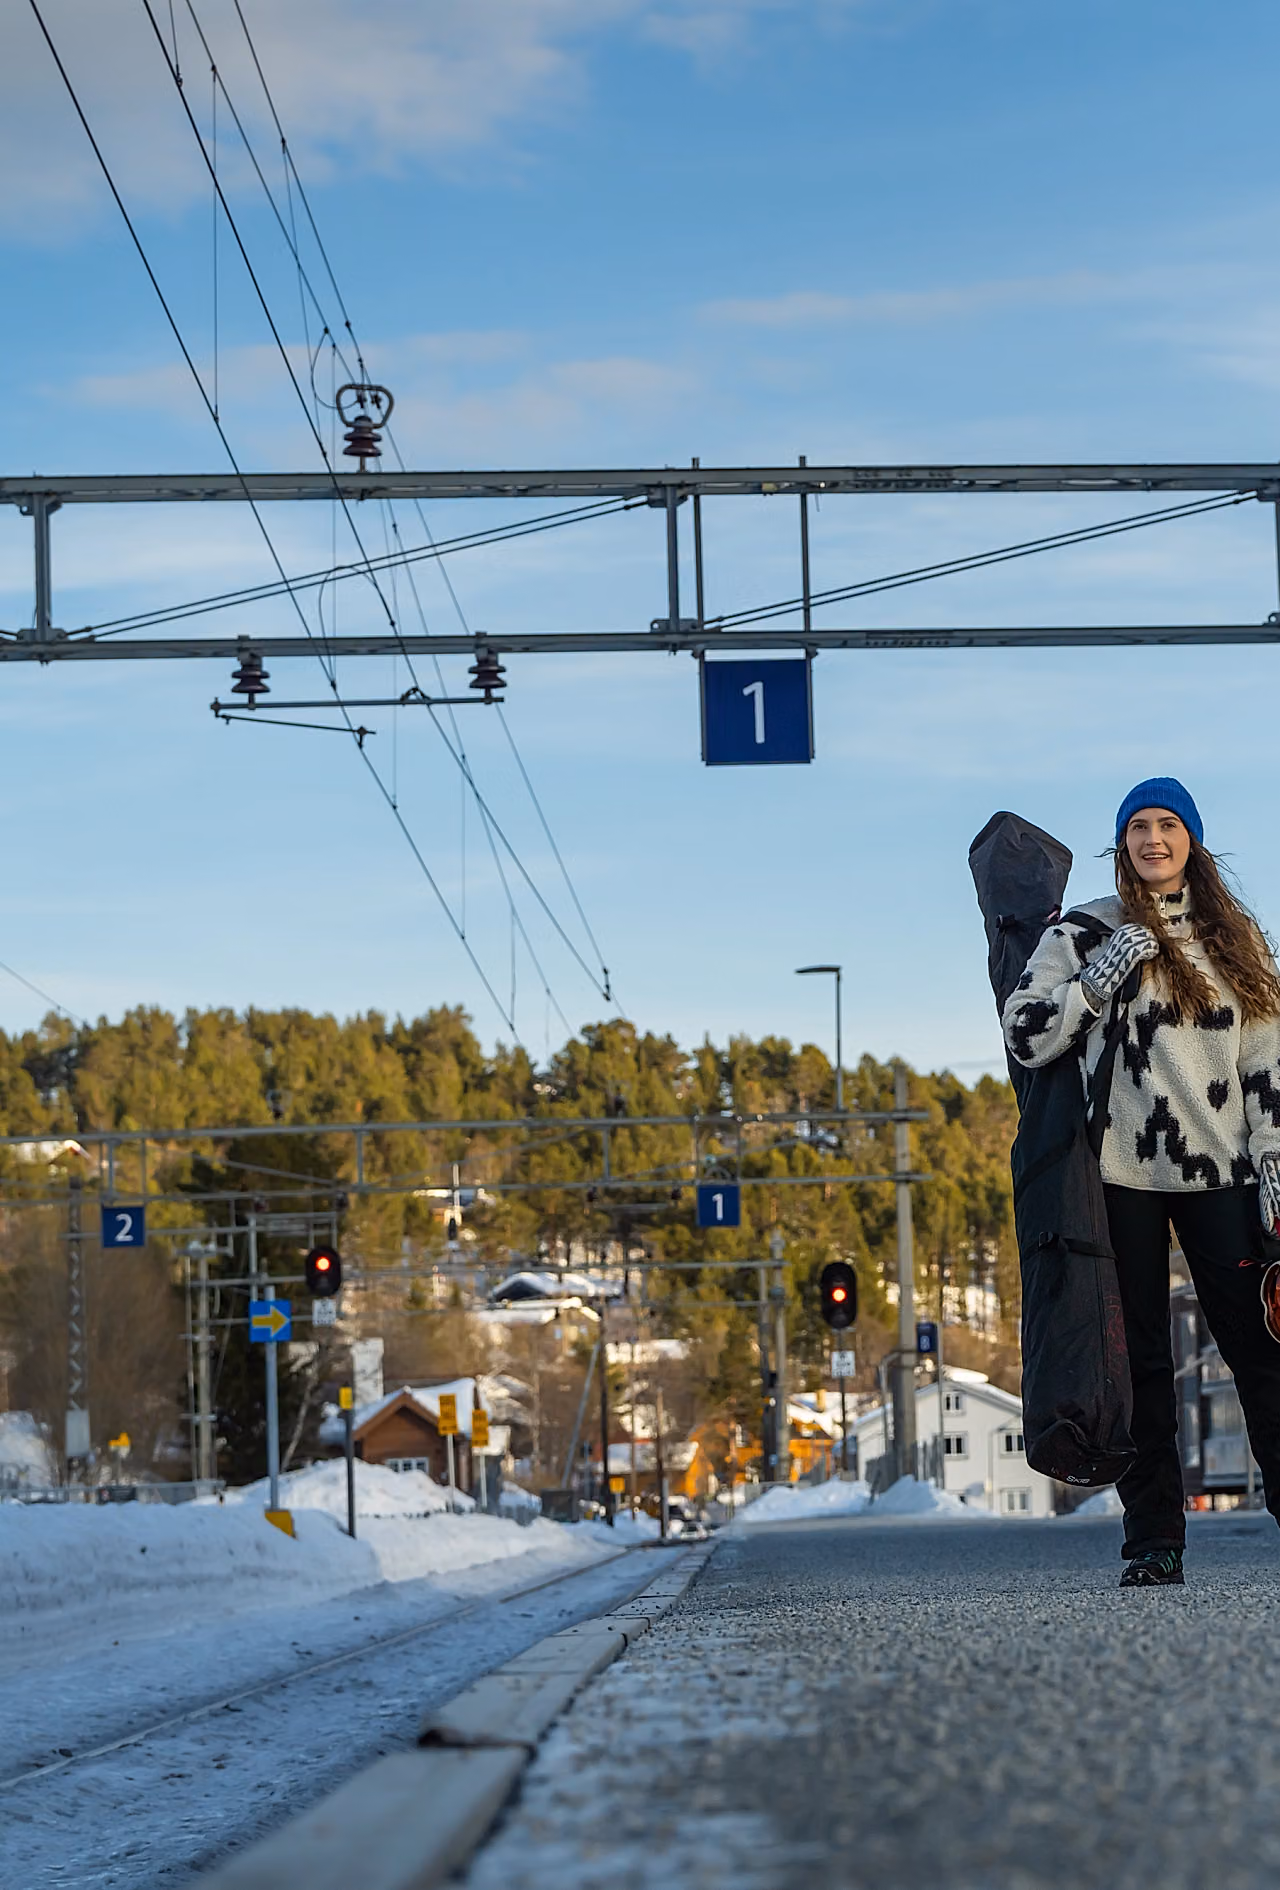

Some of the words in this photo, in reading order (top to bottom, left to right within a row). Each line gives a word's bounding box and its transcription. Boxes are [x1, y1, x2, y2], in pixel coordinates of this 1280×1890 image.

[742, 680, 765, 744] 1
[712, 1192, 723, 1221] 1
[115, 1213, 134, 1242] 2
